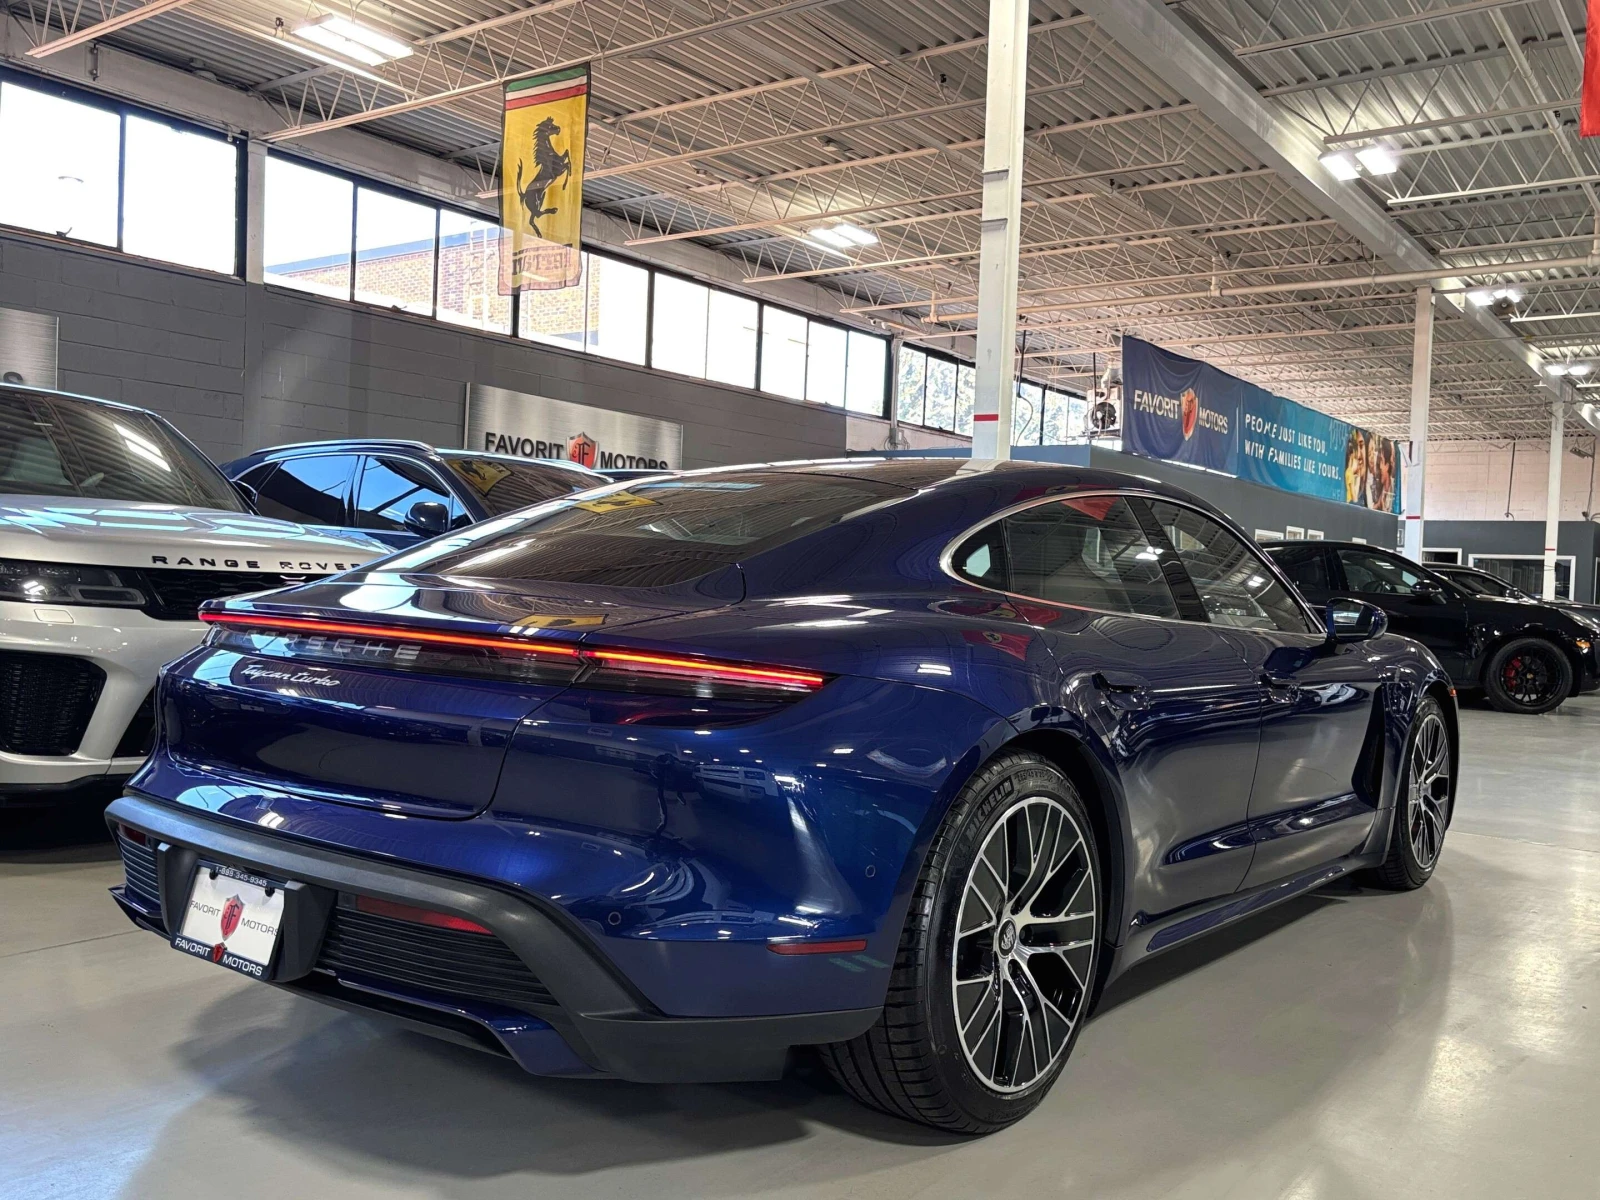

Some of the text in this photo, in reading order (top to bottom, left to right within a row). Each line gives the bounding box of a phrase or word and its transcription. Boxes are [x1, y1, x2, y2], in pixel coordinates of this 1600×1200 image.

[1134, 390, 1228, 434] FAVORIT MOTORS
[485, 432, 563, 460] FAVORIT
[600, 451, 668, 470] MOTORS
[1278, 425, 1295, 443] JUST
[1298, 431, 1312, 450] LIKE
[1244, 440, 1265, 460] WITH
[1267, 447, 1301, 471] FAMILIES
[1303, 458, 1316, 474] LIKE
[151, 555, 260, 569] RANGE
[241, 664, 291, 680] Taycan
[966, 778, 1012, 841] MICHELIN
[189, 900, 221, 918] FAVORIT
[241, 917, 279, 937] MOTORS
[175, 937, 211, 957] FAVORIT
[223, 954, 263, 976] MOTORS
